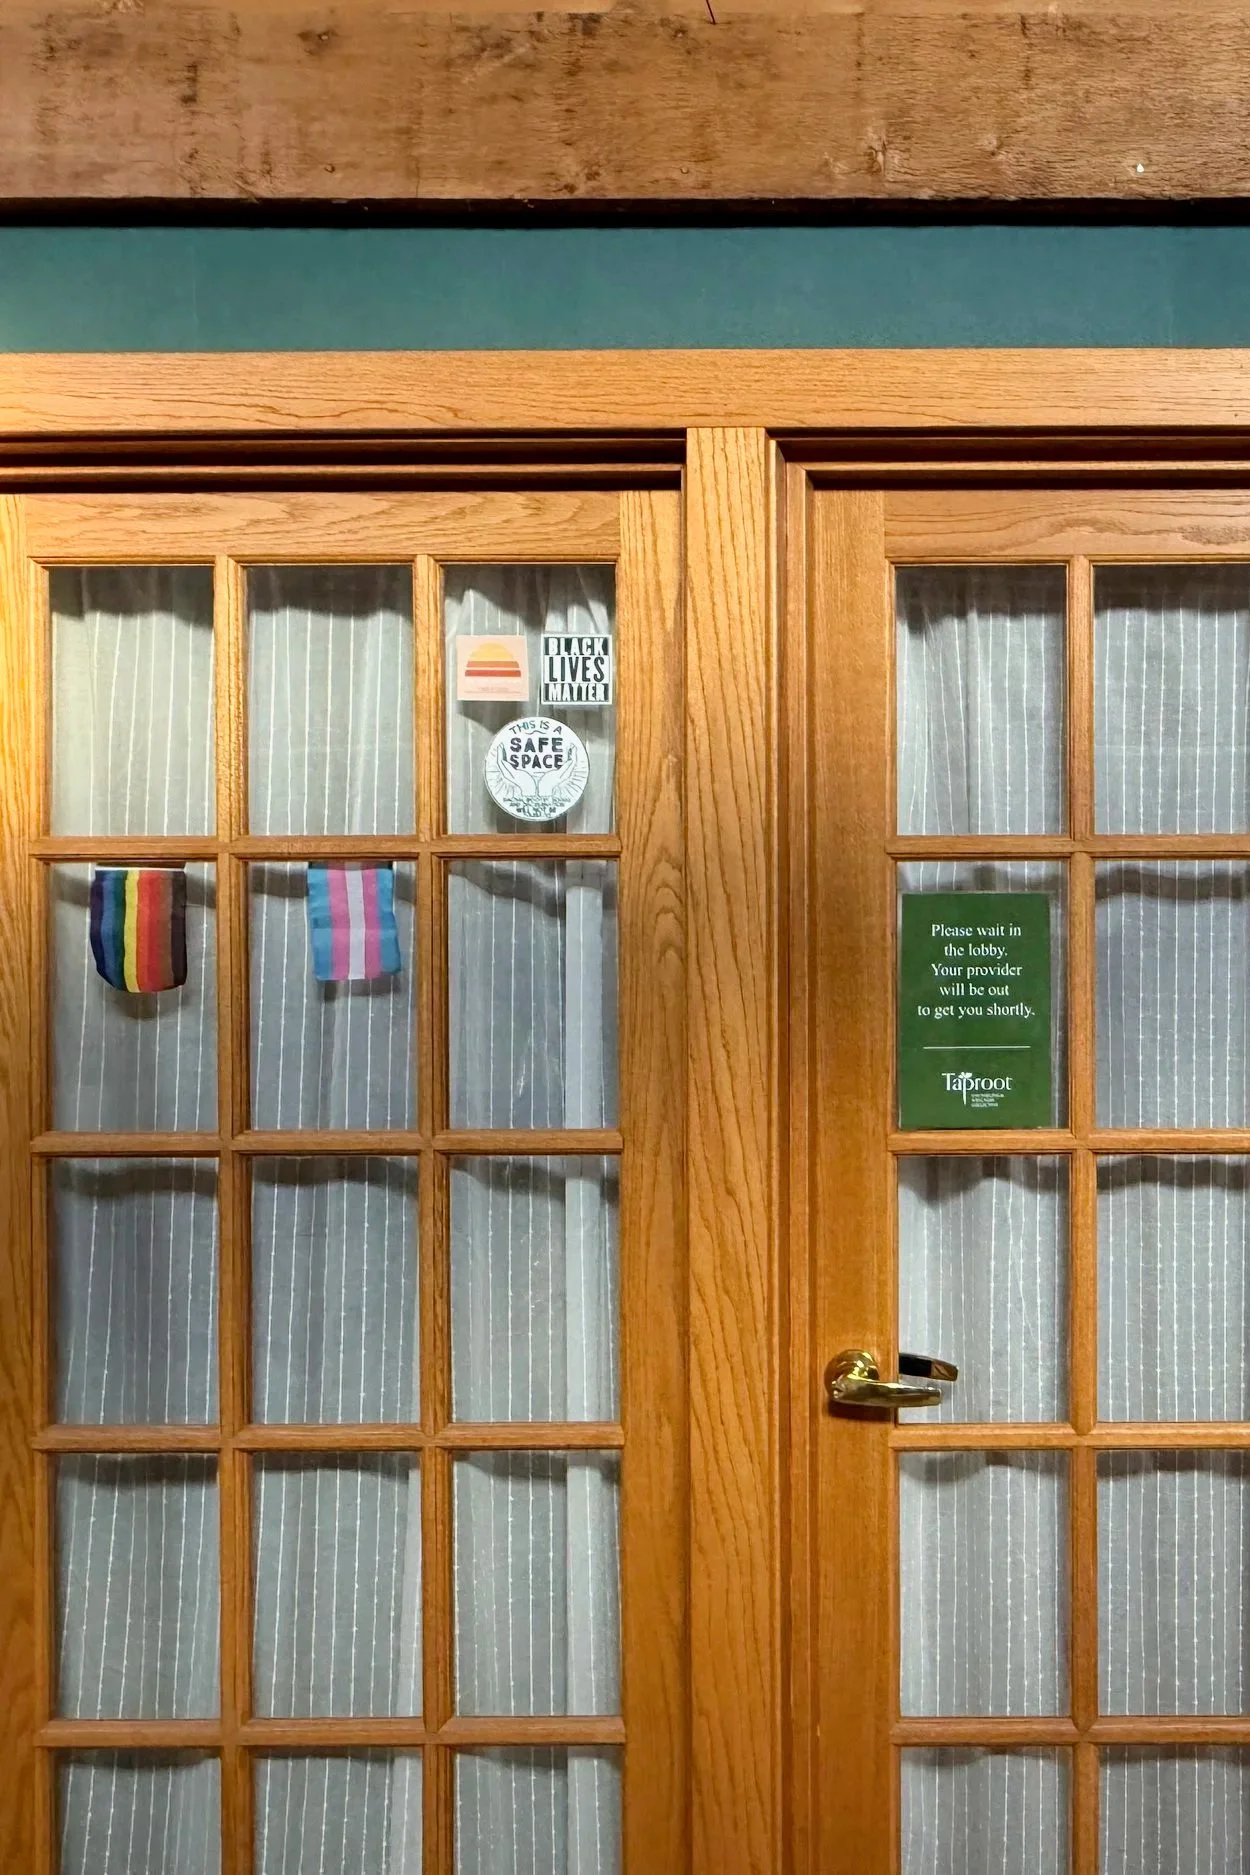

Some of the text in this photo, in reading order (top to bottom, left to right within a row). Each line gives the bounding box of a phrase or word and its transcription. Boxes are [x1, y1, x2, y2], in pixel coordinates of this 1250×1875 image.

[549, 637, 604, 656] BLACK
[549, 656, 605, 683] LIVES
[549, 683, 605, 701] MATTER
[508, 720, 562, 736] THIS IS A
[510, 737, 564, 753] SAFE
[510, 754, 564, 769] SPACE
[931, 923, 1022, 937] Please wait in
[944, 943, 1008, 960] the lobby.
[931, 962, 1023, 980] Your provider
[939, 982, 1010, 996] will be out
[917, 1002, 1035, 1020] to get you shortly.
[941, 1073, 1013, 1105] Taproot
